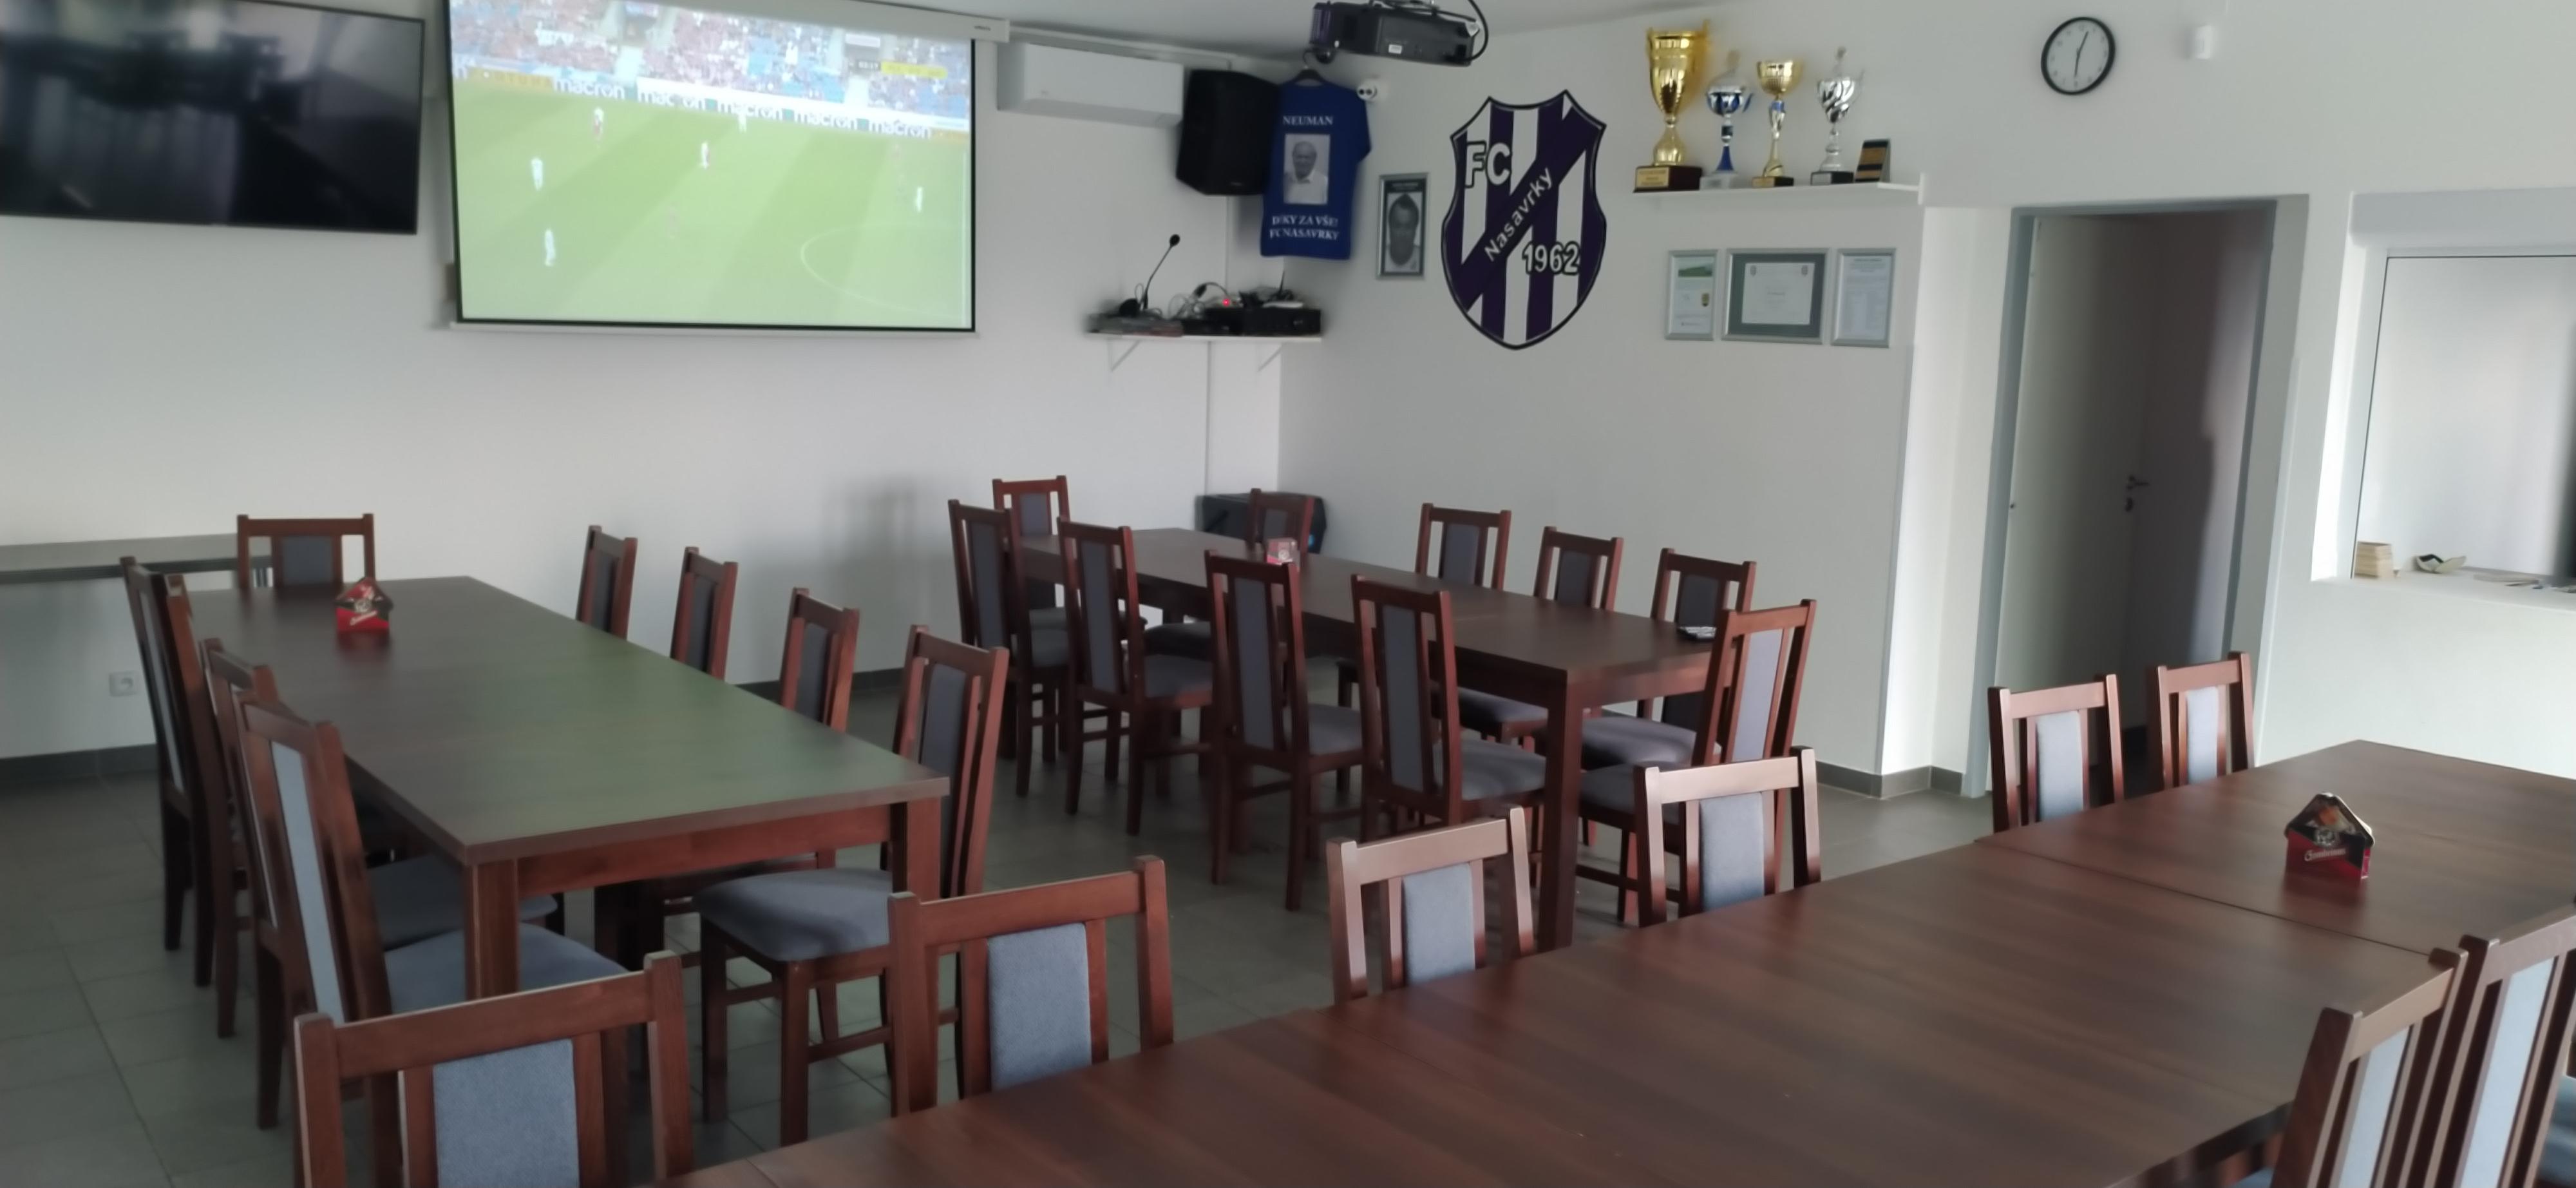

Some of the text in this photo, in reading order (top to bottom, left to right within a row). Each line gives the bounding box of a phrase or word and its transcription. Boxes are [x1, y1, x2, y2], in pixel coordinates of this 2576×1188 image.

[553, 77, 625, 100] macron
[794, 111, 858, 131] macron
[869, 119, 932, 139] macron
[1283, 115, 1333, 125] NEUMAN
[1464, 140, 1511, 189] FC
[1484, 168, 1553, 262] Nasavrky
[1522, 241, 1580, 276] 1962
